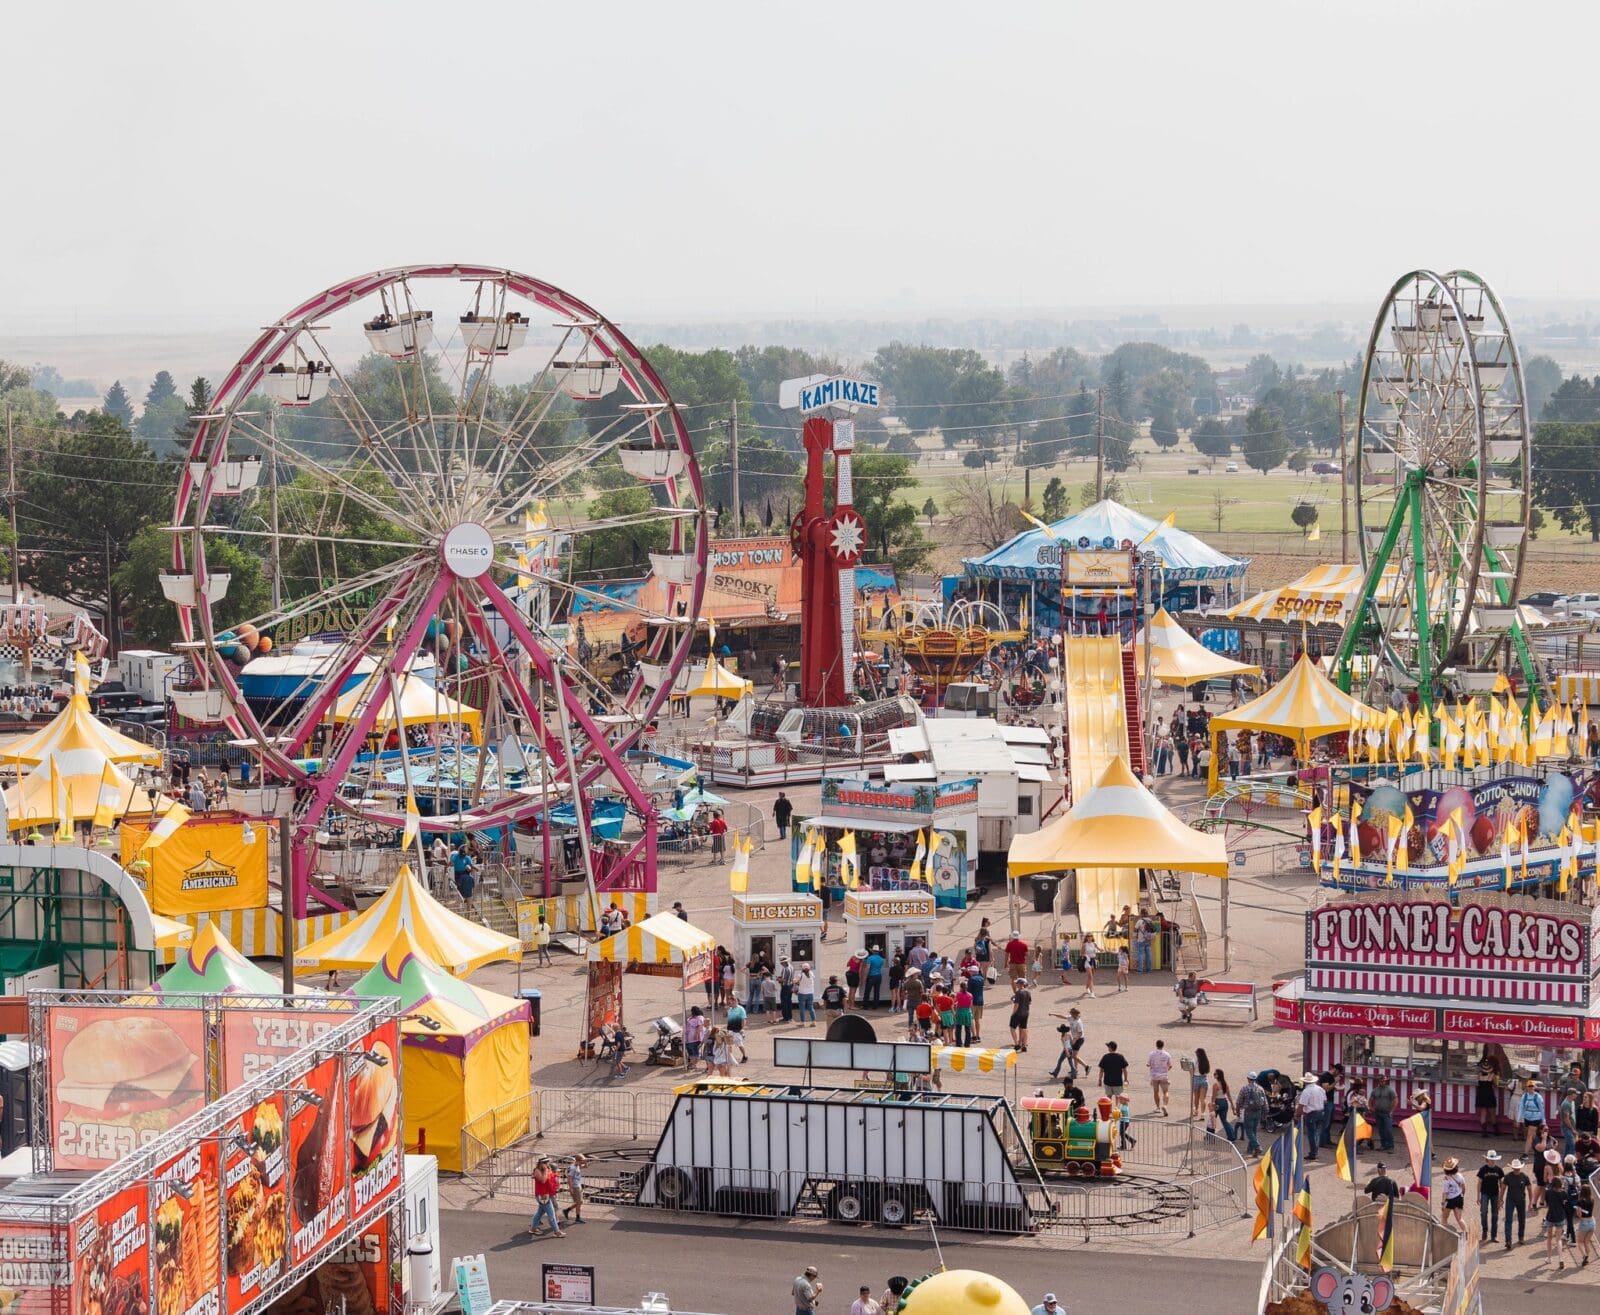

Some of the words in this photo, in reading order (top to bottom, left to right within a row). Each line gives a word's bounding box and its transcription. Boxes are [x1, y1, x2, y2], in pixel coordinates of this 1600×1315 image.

[802, 380, 877, 410] KAMIKAZE
[715, 550, 744, 567] HOST
[748, 549, 783, 565] TOWN
[714, 575, 773, 595] SPOOKY
[1274, 597, 1343, 615] SCOOTER
[275, 608, 368, 646] ABDUCT
[838, 789, 916, 808] AIRBRUSH
[1474, 785, 1507, 807] COTTON
[182, 876, 237, 890] AMERICANA
[190, 869, 230, 878] CARNIVAL
[750, 905, 816, 919] TICKETS
[864, 902, 929, 915] TICKETS
[1317, 905, 1455, 952] FUNNEL
[1462, 904, 1581, 962] CAKES
[1311, 1005, 1354, 1021] Golden
[1365, 1007, 1395, 1026] Deep
[1398, 1009, 1430, 1023] Fried
[1448, 1015, 1474, 1028] Hot
[1481, 1016, 1513, 1031] Fresh
[1521, 1019, 1575, 1035] Delicious
[354, 1145, 399, 1214] BURGERS
[294, 1205, 329, 1261] TURKEY
[329, 1185, 346, 1229] LEGS
[113, 1222, 146, 1268] BUFFALO
